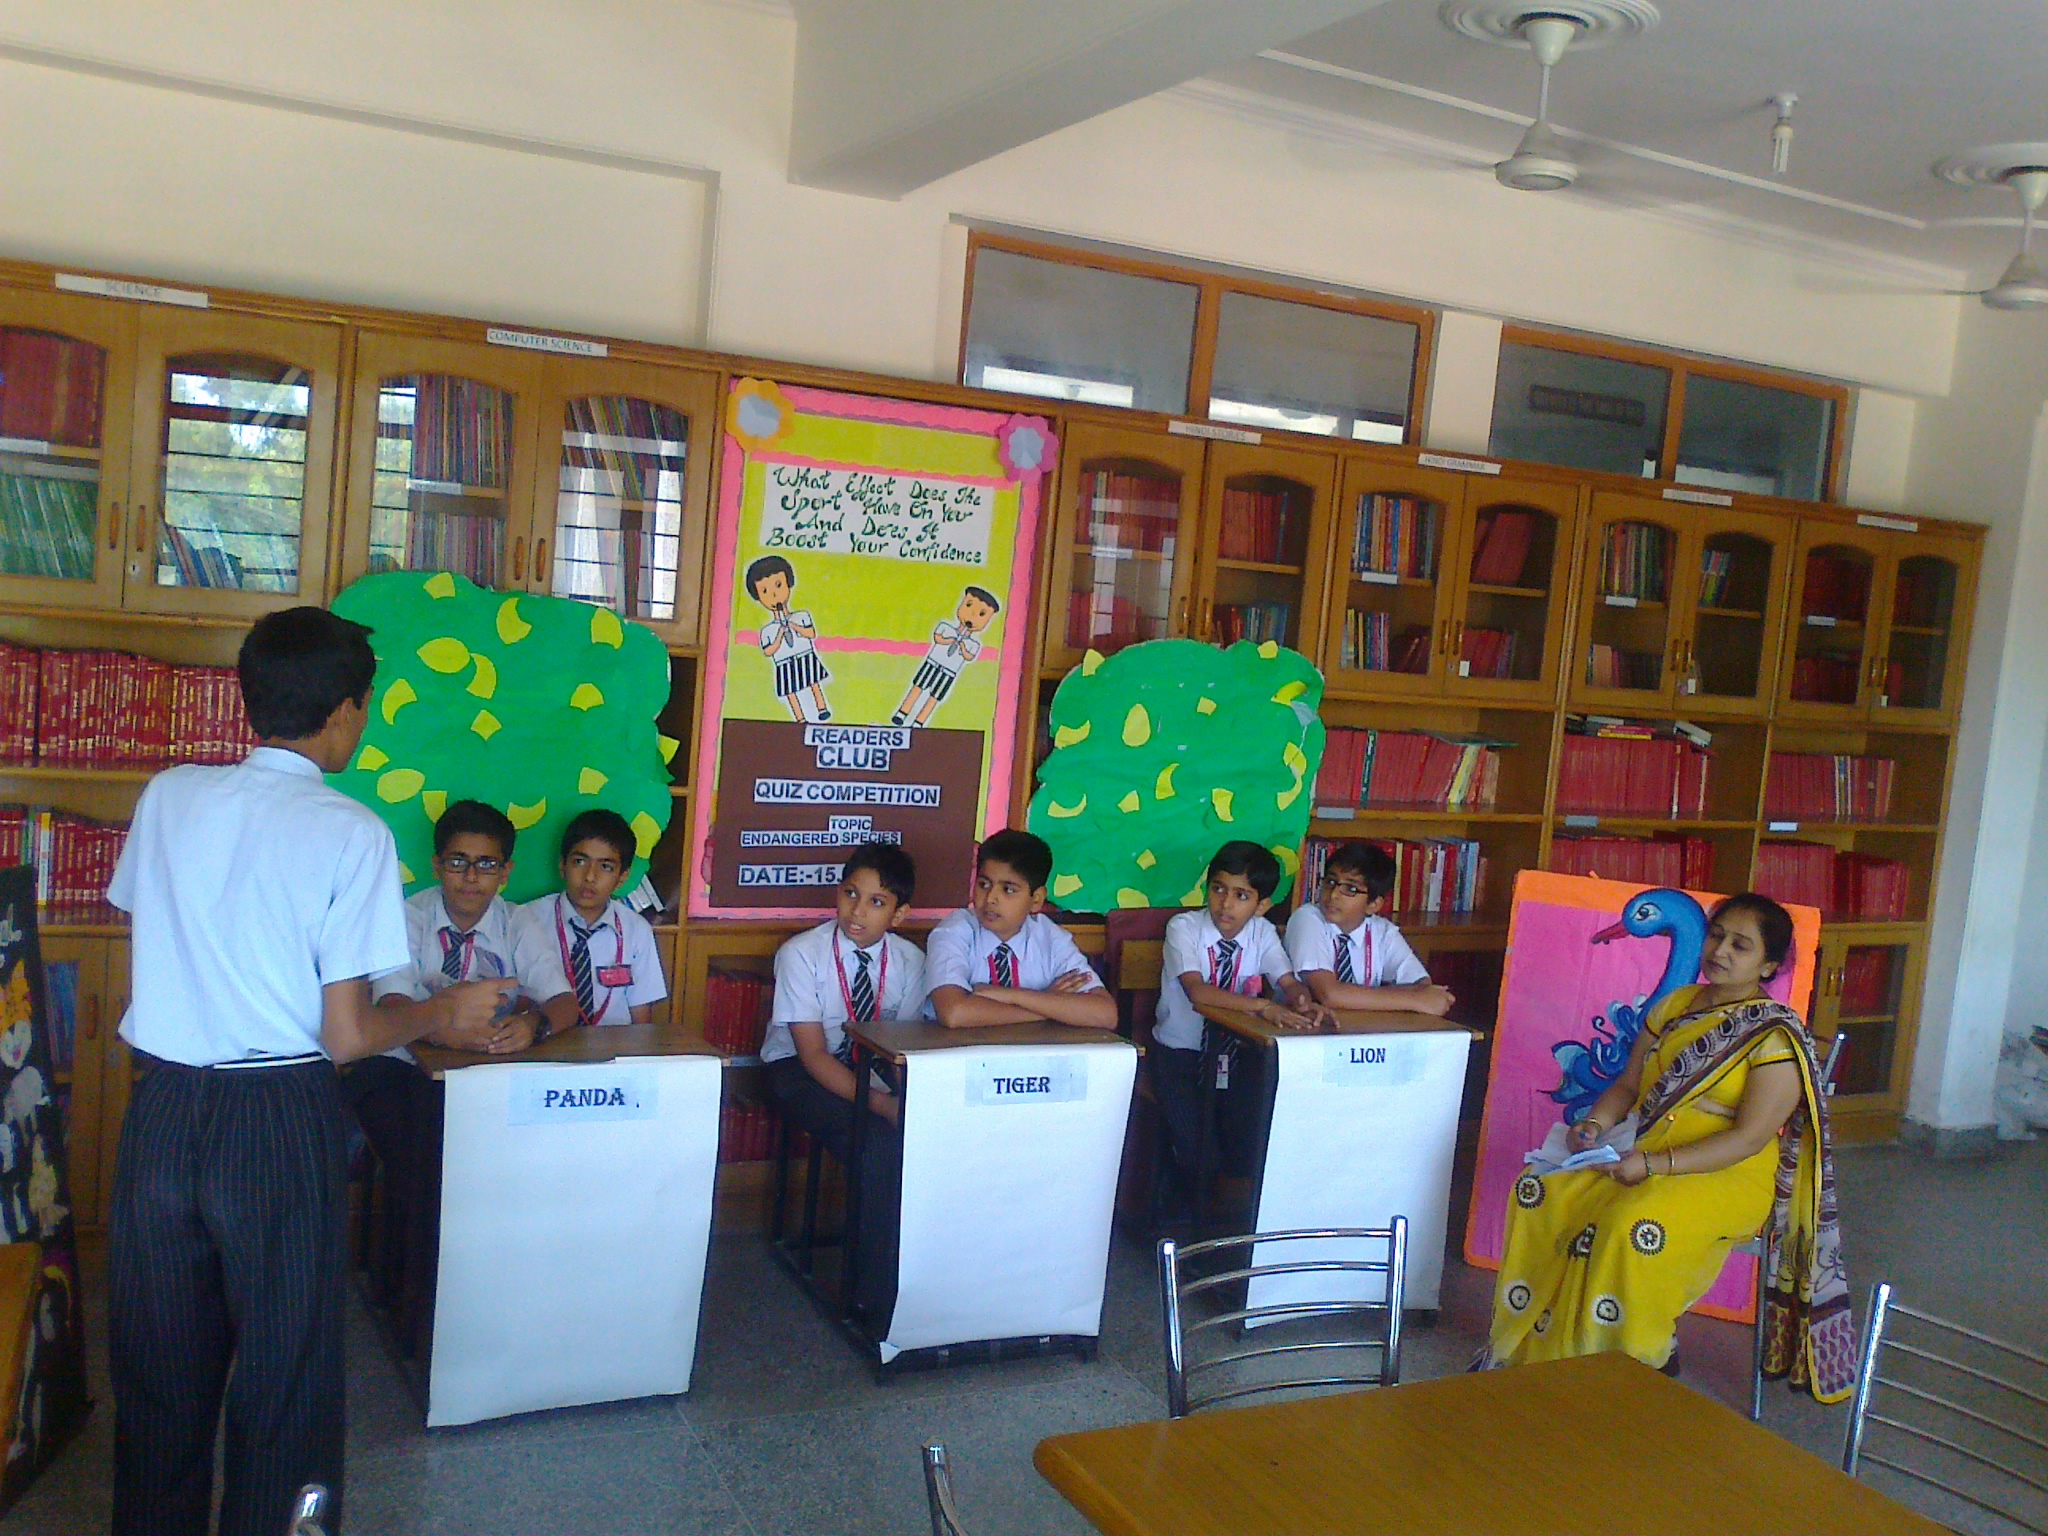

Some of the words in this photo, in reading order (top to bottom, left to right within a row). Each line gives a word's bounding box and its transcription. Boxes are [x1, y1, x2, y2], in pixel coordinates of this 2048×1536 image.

[488, 330, 548, 347] COMPUTER
[550, 338, 593, 353] SCIENCE
[773, 466, 832, 490] What
[845, 472, 896, 501] Effect
[909, 480, 948, 502] Does
[954, 486, 981, 506] The
[781, 488, 842, 520] Sport
[862, 497, 901, 516] Have
[910, 500, 933, 519] On
[942, 503, 973, 523] You
[795, 512, 845, 532] And
[861, 516, 908, 540] Does
[916, 521, 940, 542] It
[765, 527, 828, 549] Boost
[849, 532, 889, 553] Your
[899, 539, 981, 563] Confidence
[811, 728, 904, 746] READERS
[818, 746, 888, 769] CLUB
[755, 781, 803, 800] QUIZ
[806, 783, 938, 805] COMPETITION
[830, 818, 872, 831] TOPIC
[741, 832, 839, 845] ENDANGERED
[842, 831, 900, 844] SPECIES
[739, 866, 846, 884] DATE:-15.
[1350, 1047, 1386, 1063] LION
[993, 1076, 1051, 1094] TIGER
[544, 1087, 626, 1108] PANDA
